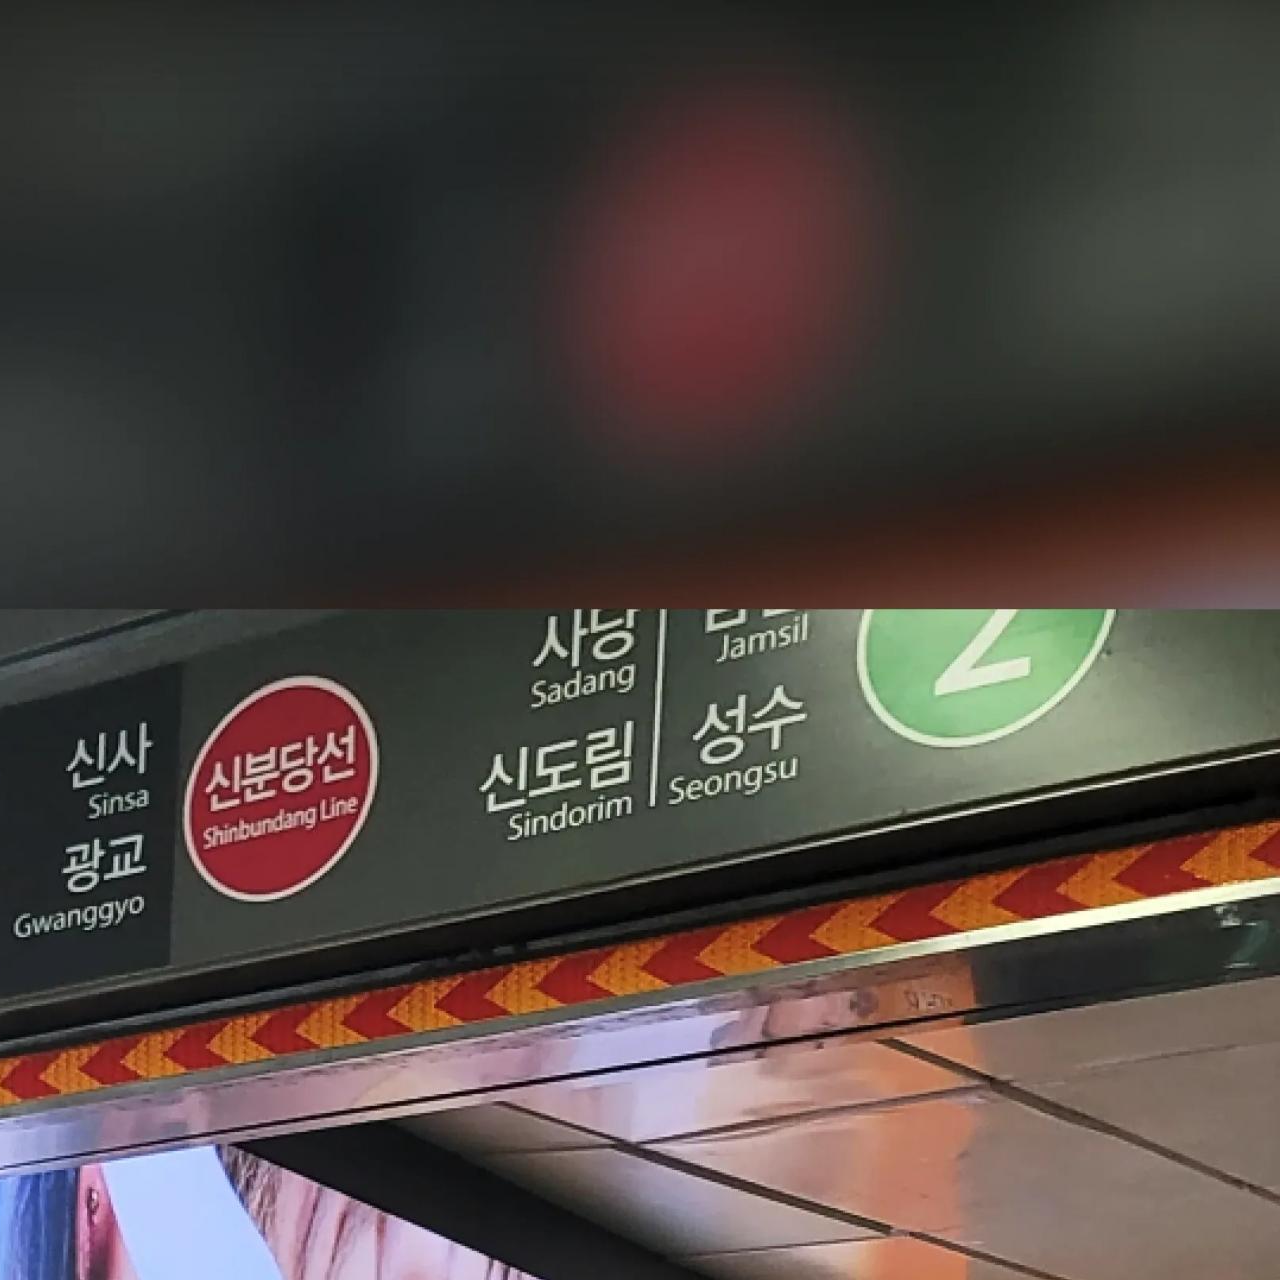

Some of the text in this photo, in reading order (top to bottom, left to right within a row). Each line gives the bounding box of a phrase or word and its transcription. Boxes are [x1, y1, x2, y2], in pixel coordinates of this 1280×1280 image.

[715, 616, 809, 664] Jamsil
[530, 664, 637, 708] Sadang
[691, 685, 808, 765] 성수
[65, 722, 153, 790] 신사
[204, 723, 358, 812] 신분당선
[479, 720, 635, 814] 신도림
[668, 755, 799, 806] Seongsu
[87, 789, 150, 819] Sinsa
[203, 795, 359, 850] Shinbundang Line
[506, 791, 634, 842] Sindorim
[61, 834, 148, 893] 광교
[13, 894, 145, 939] Gwanggyo
